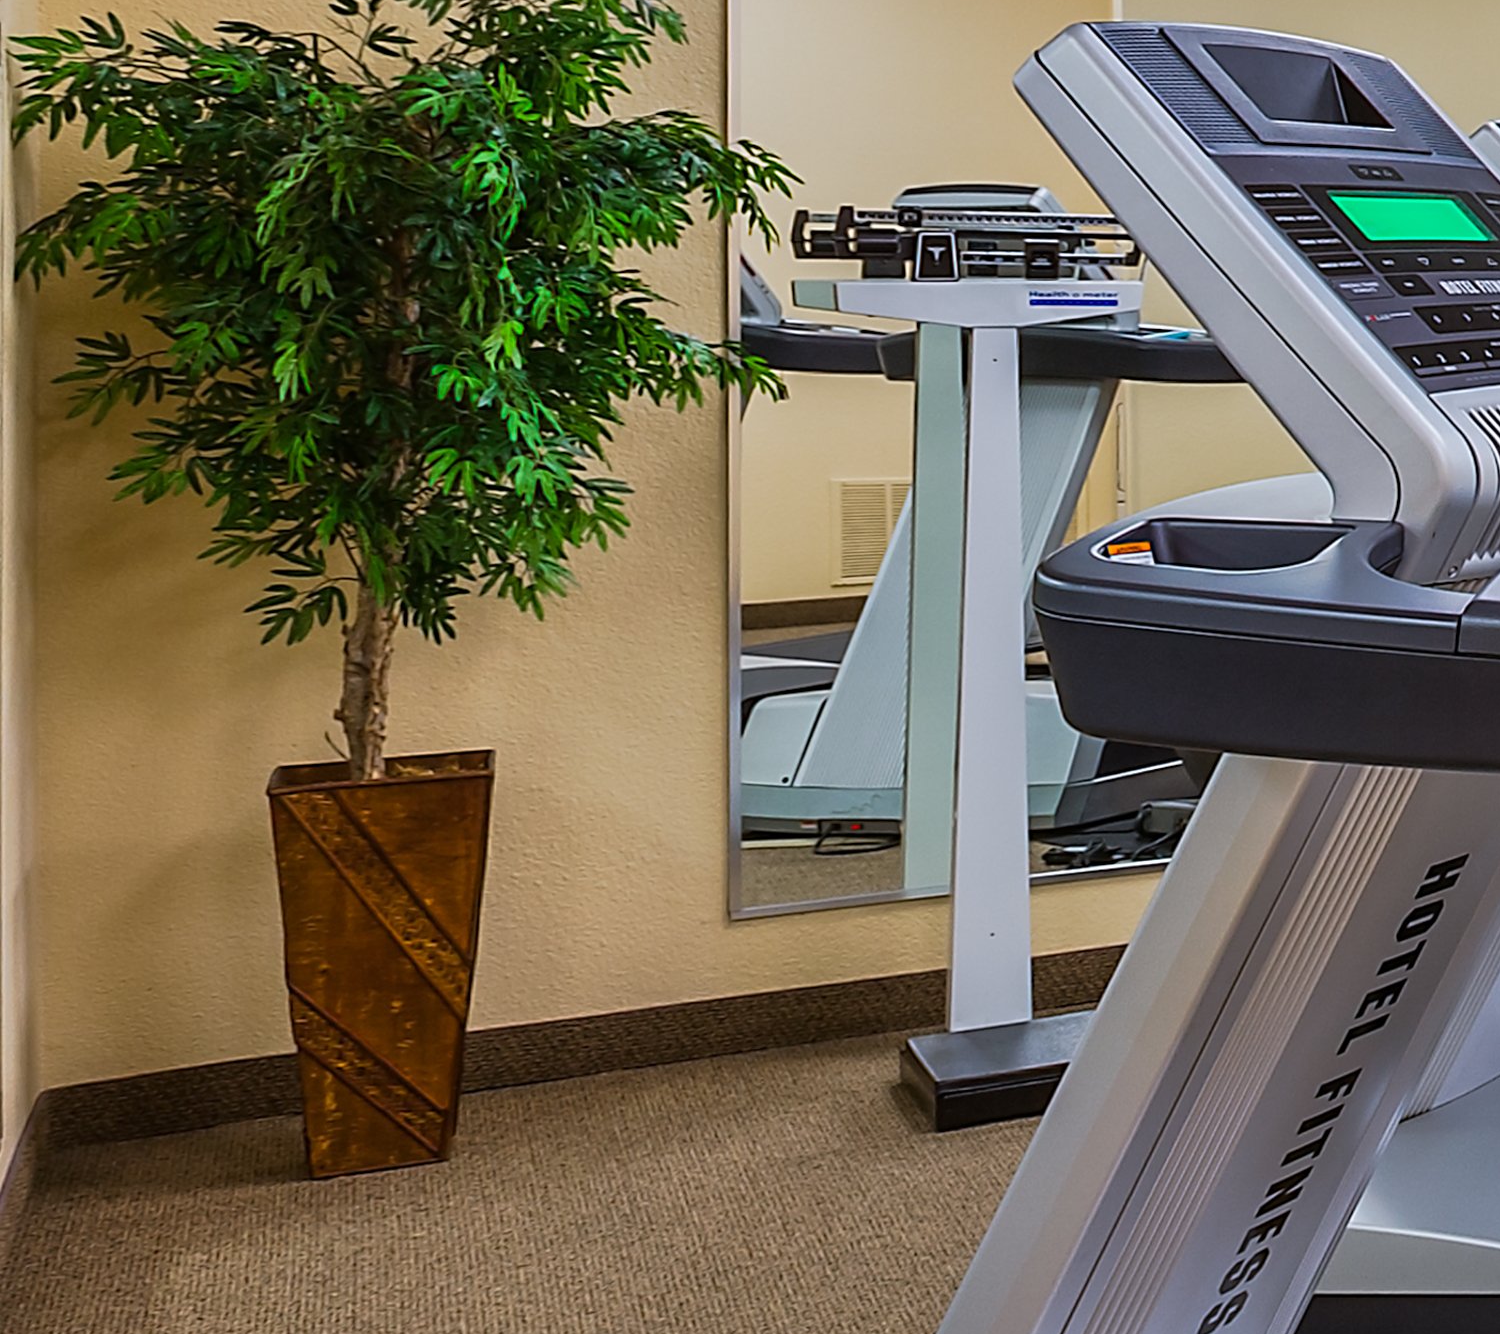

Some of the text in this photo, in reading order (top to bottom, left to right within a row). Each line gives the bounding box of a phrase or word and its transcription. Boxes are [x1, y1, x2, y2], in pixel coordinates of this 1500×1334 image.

[1029, 290, 1070, 298] Health
[1439, 280, 1480, 294] HOTEL
[1336, 852, 1469, 1057] HOTEL
